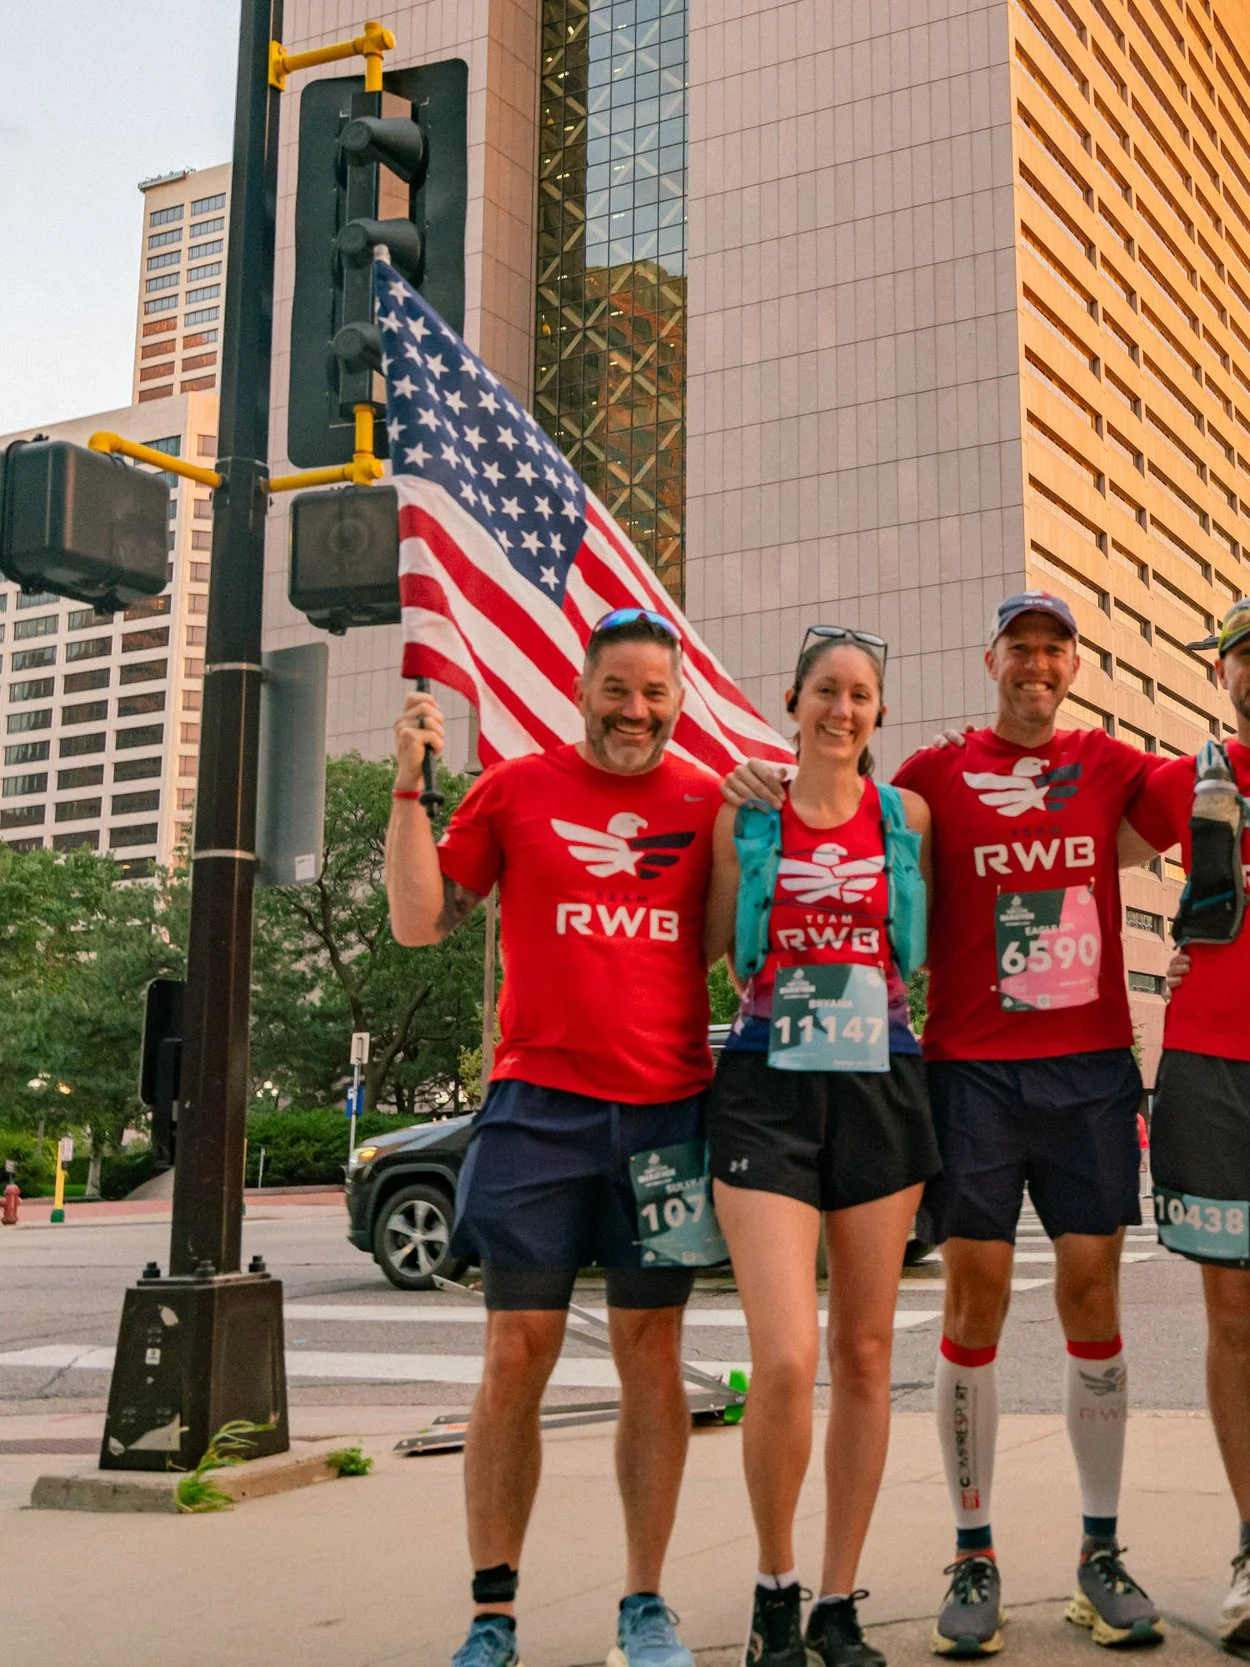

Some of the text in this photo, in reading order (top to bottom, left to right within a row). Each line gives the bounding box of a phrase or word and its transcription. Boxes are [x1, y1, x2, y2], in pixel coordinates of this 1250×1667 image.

[974, 836, 1095, 877] RWB
[556, 903, 679, 942] RWB
[805, 914, 853, 924] TEAM
[777, 926, 879, 954] RWB
[1001, 934, 1098, 975] 6590
[774, 1015, 885, 1044] 11147
[1155, 1195, 1245, 1235] 10438
